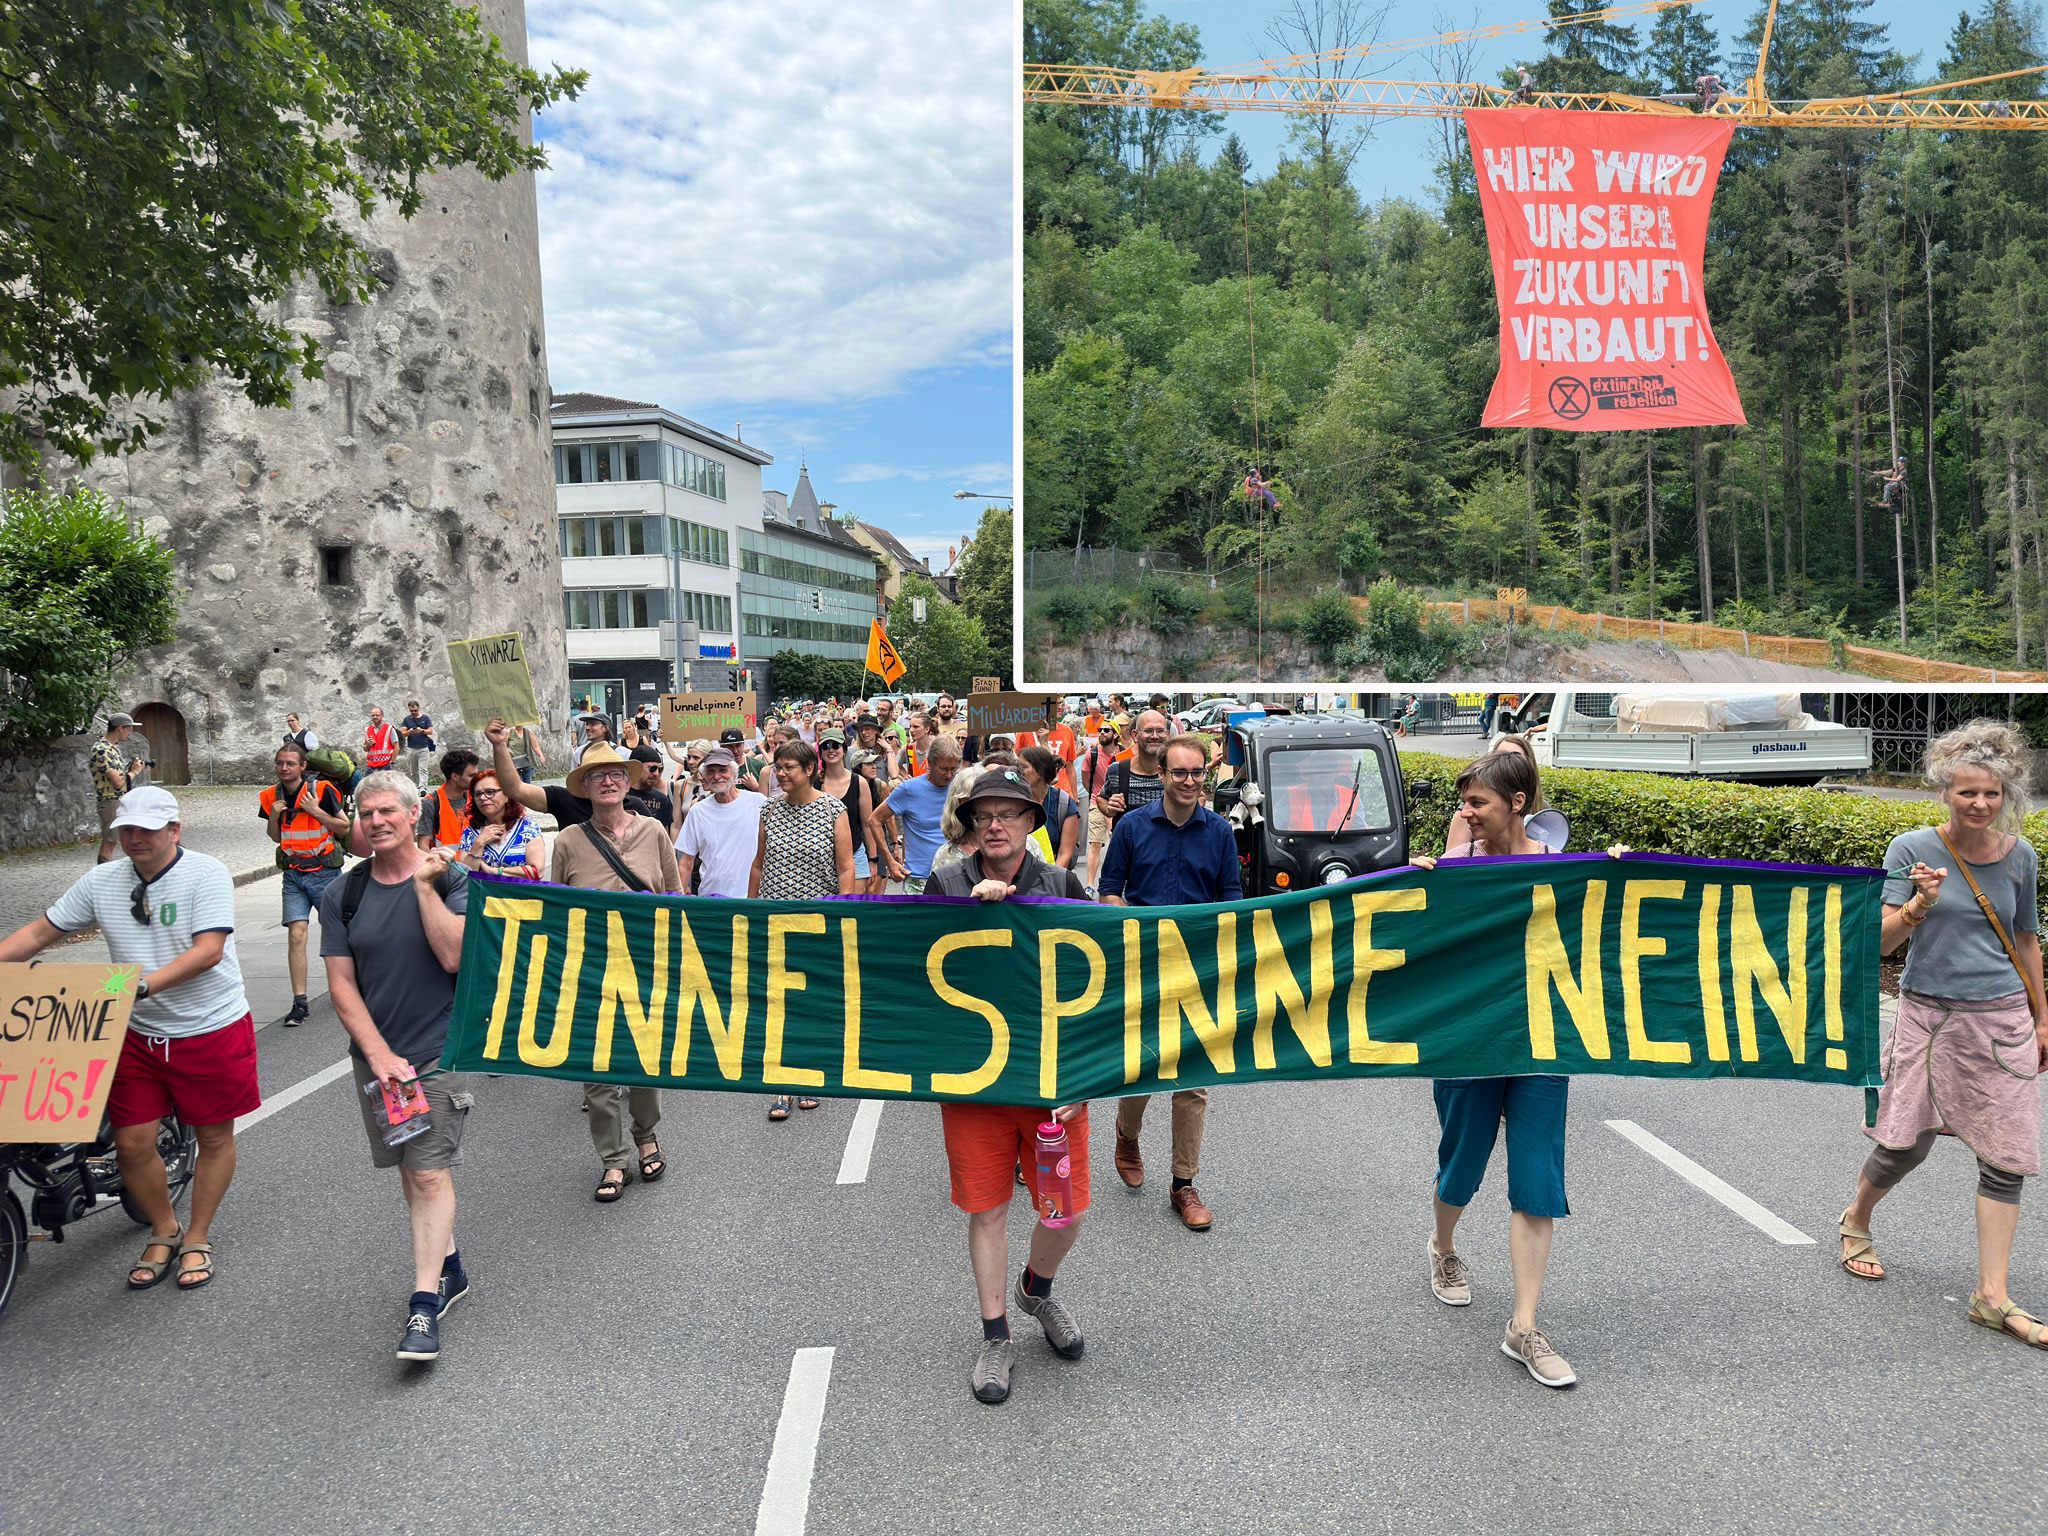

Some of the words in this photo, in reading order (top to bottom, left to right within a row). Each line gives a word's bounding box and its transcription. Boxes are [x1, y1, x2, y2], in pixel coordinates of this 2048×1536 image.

[1482, 146, 1575, 192] HIER
[1592, 149, 1708, 197] WIRD
[1523, 204, 1676, 250] UNSERE
[1513, 258, 1690, 306] ZUKUNFT
[1510, 314, 1710, 363] VERBAUT!
[1613, 390, 1676, 408] rebellion
[470, 638, 520, 667] SCHWARZ
[667, 696, 744, 714] Tunnelspinne?
[675, 713, 718, 728] SPINNT
[1752, 742, 1807, 754] glasbau.li
[1524, 879, 1848, 1070] NEIN!
[0, 987, 120, 1042] SPINNE
[24, 1057, 109, 1122] ÜS!
